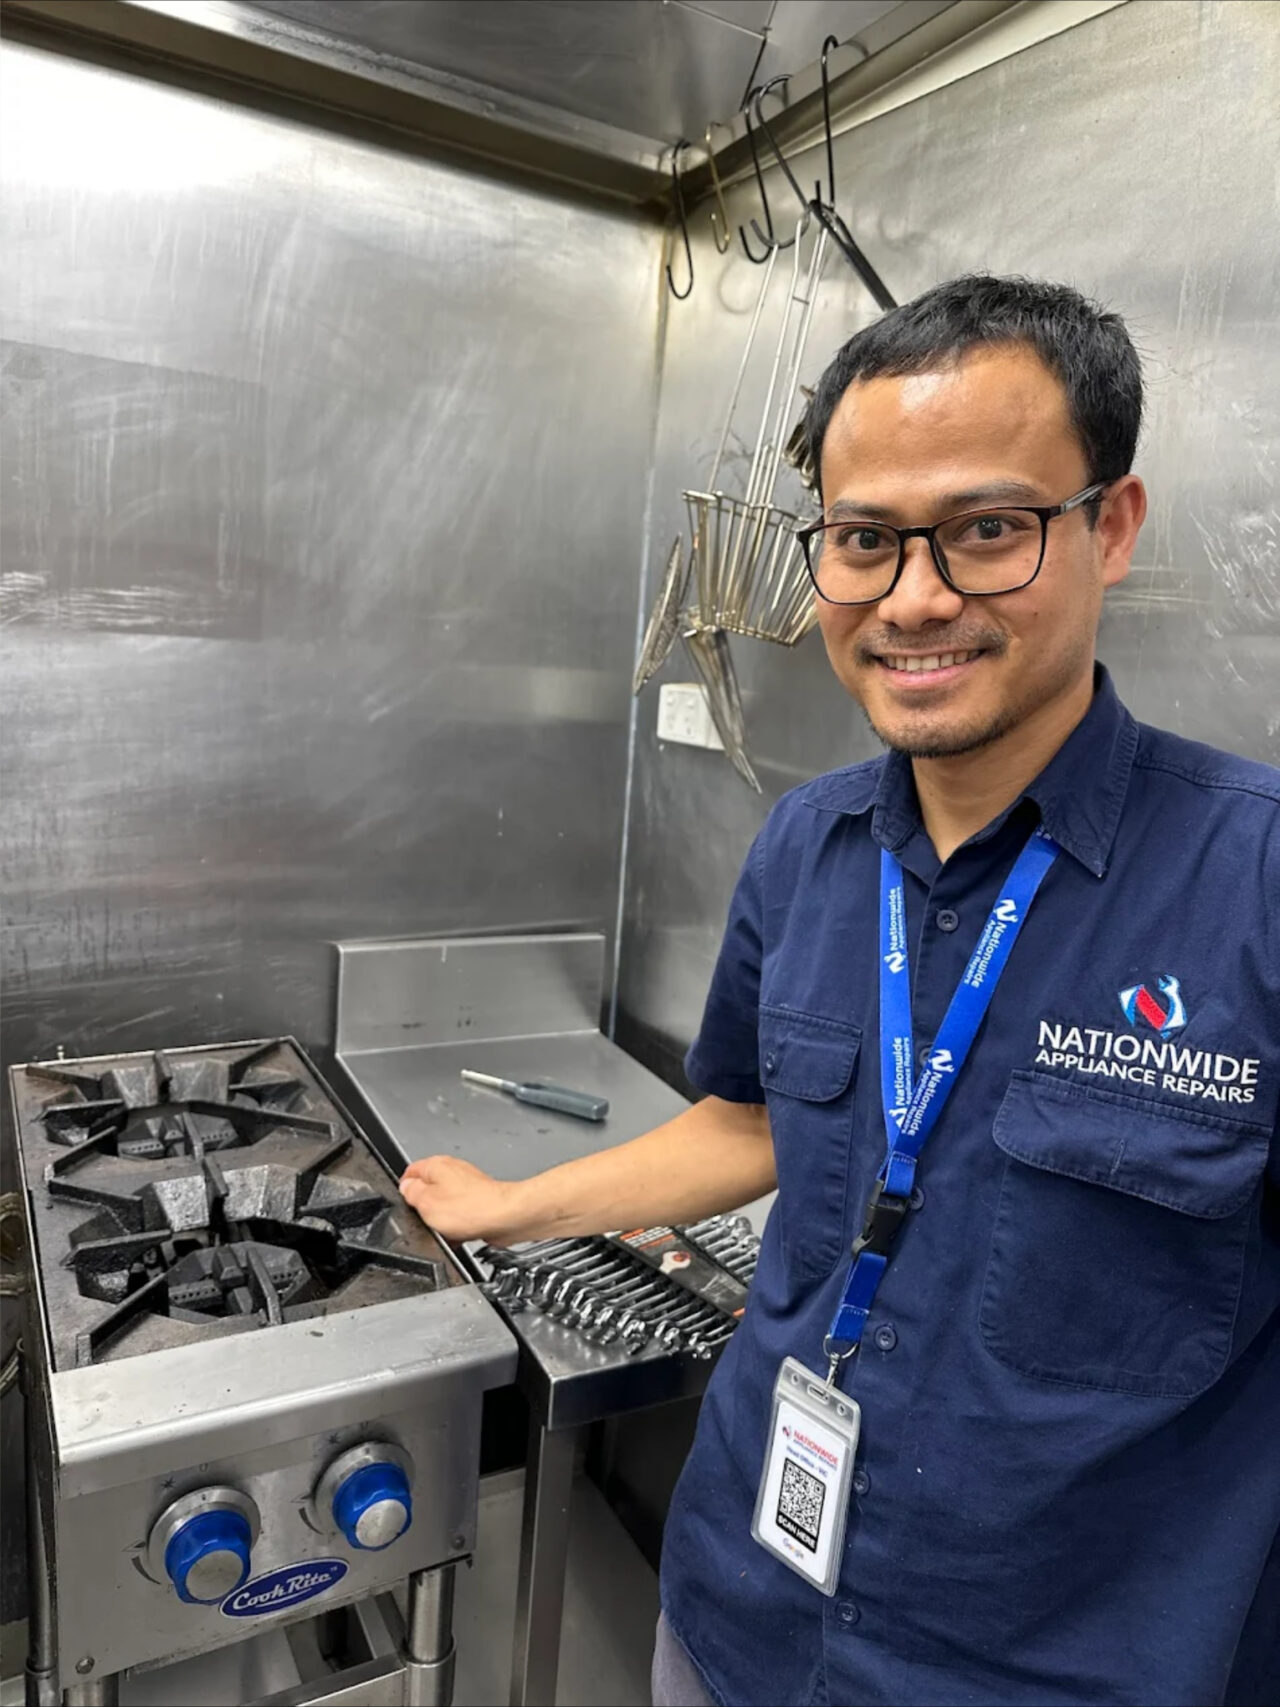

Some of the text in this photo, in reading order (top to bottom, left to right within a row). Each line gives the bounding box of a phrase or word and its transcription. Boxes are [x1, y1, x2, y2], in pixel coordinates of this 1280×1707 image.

[889, 888, 898, 951] Nationwide
[971, 921, 1007, 988] Nationwide
[893, 1037, 905, 1106] Nationwide
[1035, 1049, 1256, 1103] APPLIANCE REPAIRS
[1037, 1021, 1261, 1085] NATIONWIDE
[908, 1072, 942, 1136] Nationwide
[794, 1430, 838, 1465] NATIONWIDE
[778, 1515, 816, 1549] SCAN HERE
